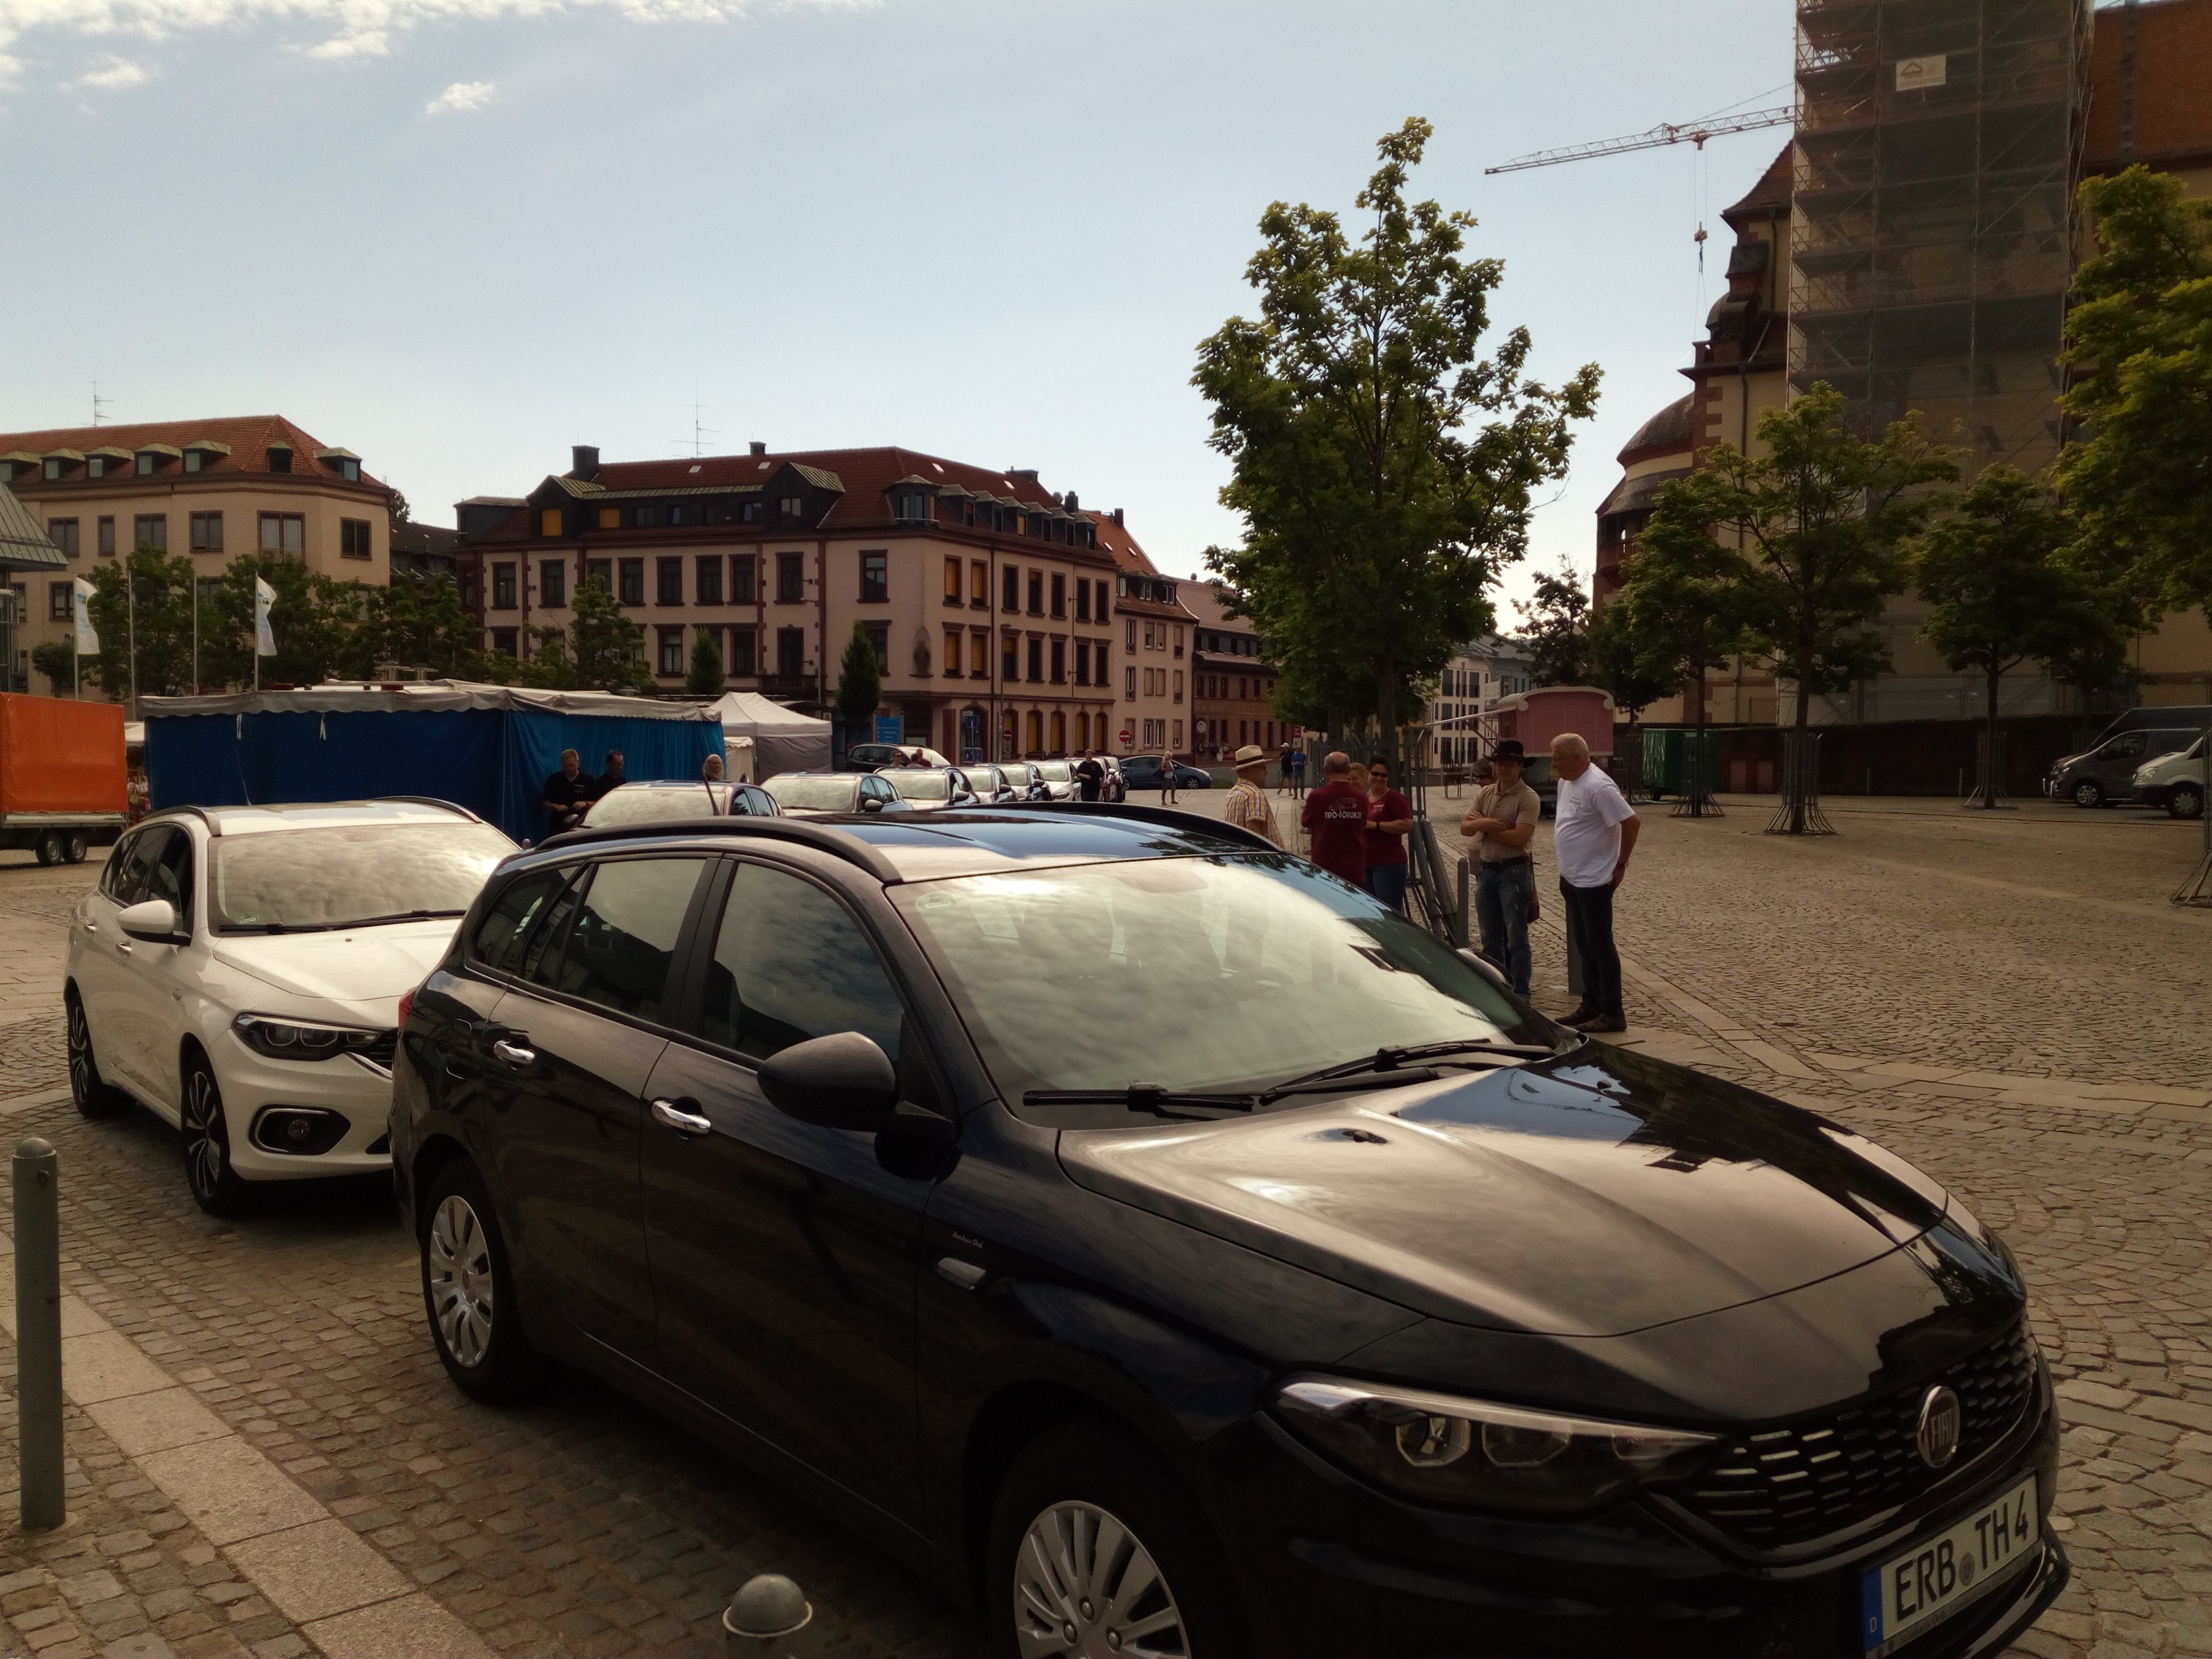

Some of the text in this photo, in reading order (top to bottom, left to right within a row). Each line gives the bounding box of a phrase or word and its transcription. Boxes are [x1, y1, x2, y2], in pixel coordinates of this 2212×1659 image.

[1930, 1408, 1953, 1451] FIAT
[1895, 1538, 1956, 1621] ERB
[1975, 1501, 2010, 1570] TH
[2014, 1489, 2028, 1542] 4
[1869, 1616, 1877, 1633] D
